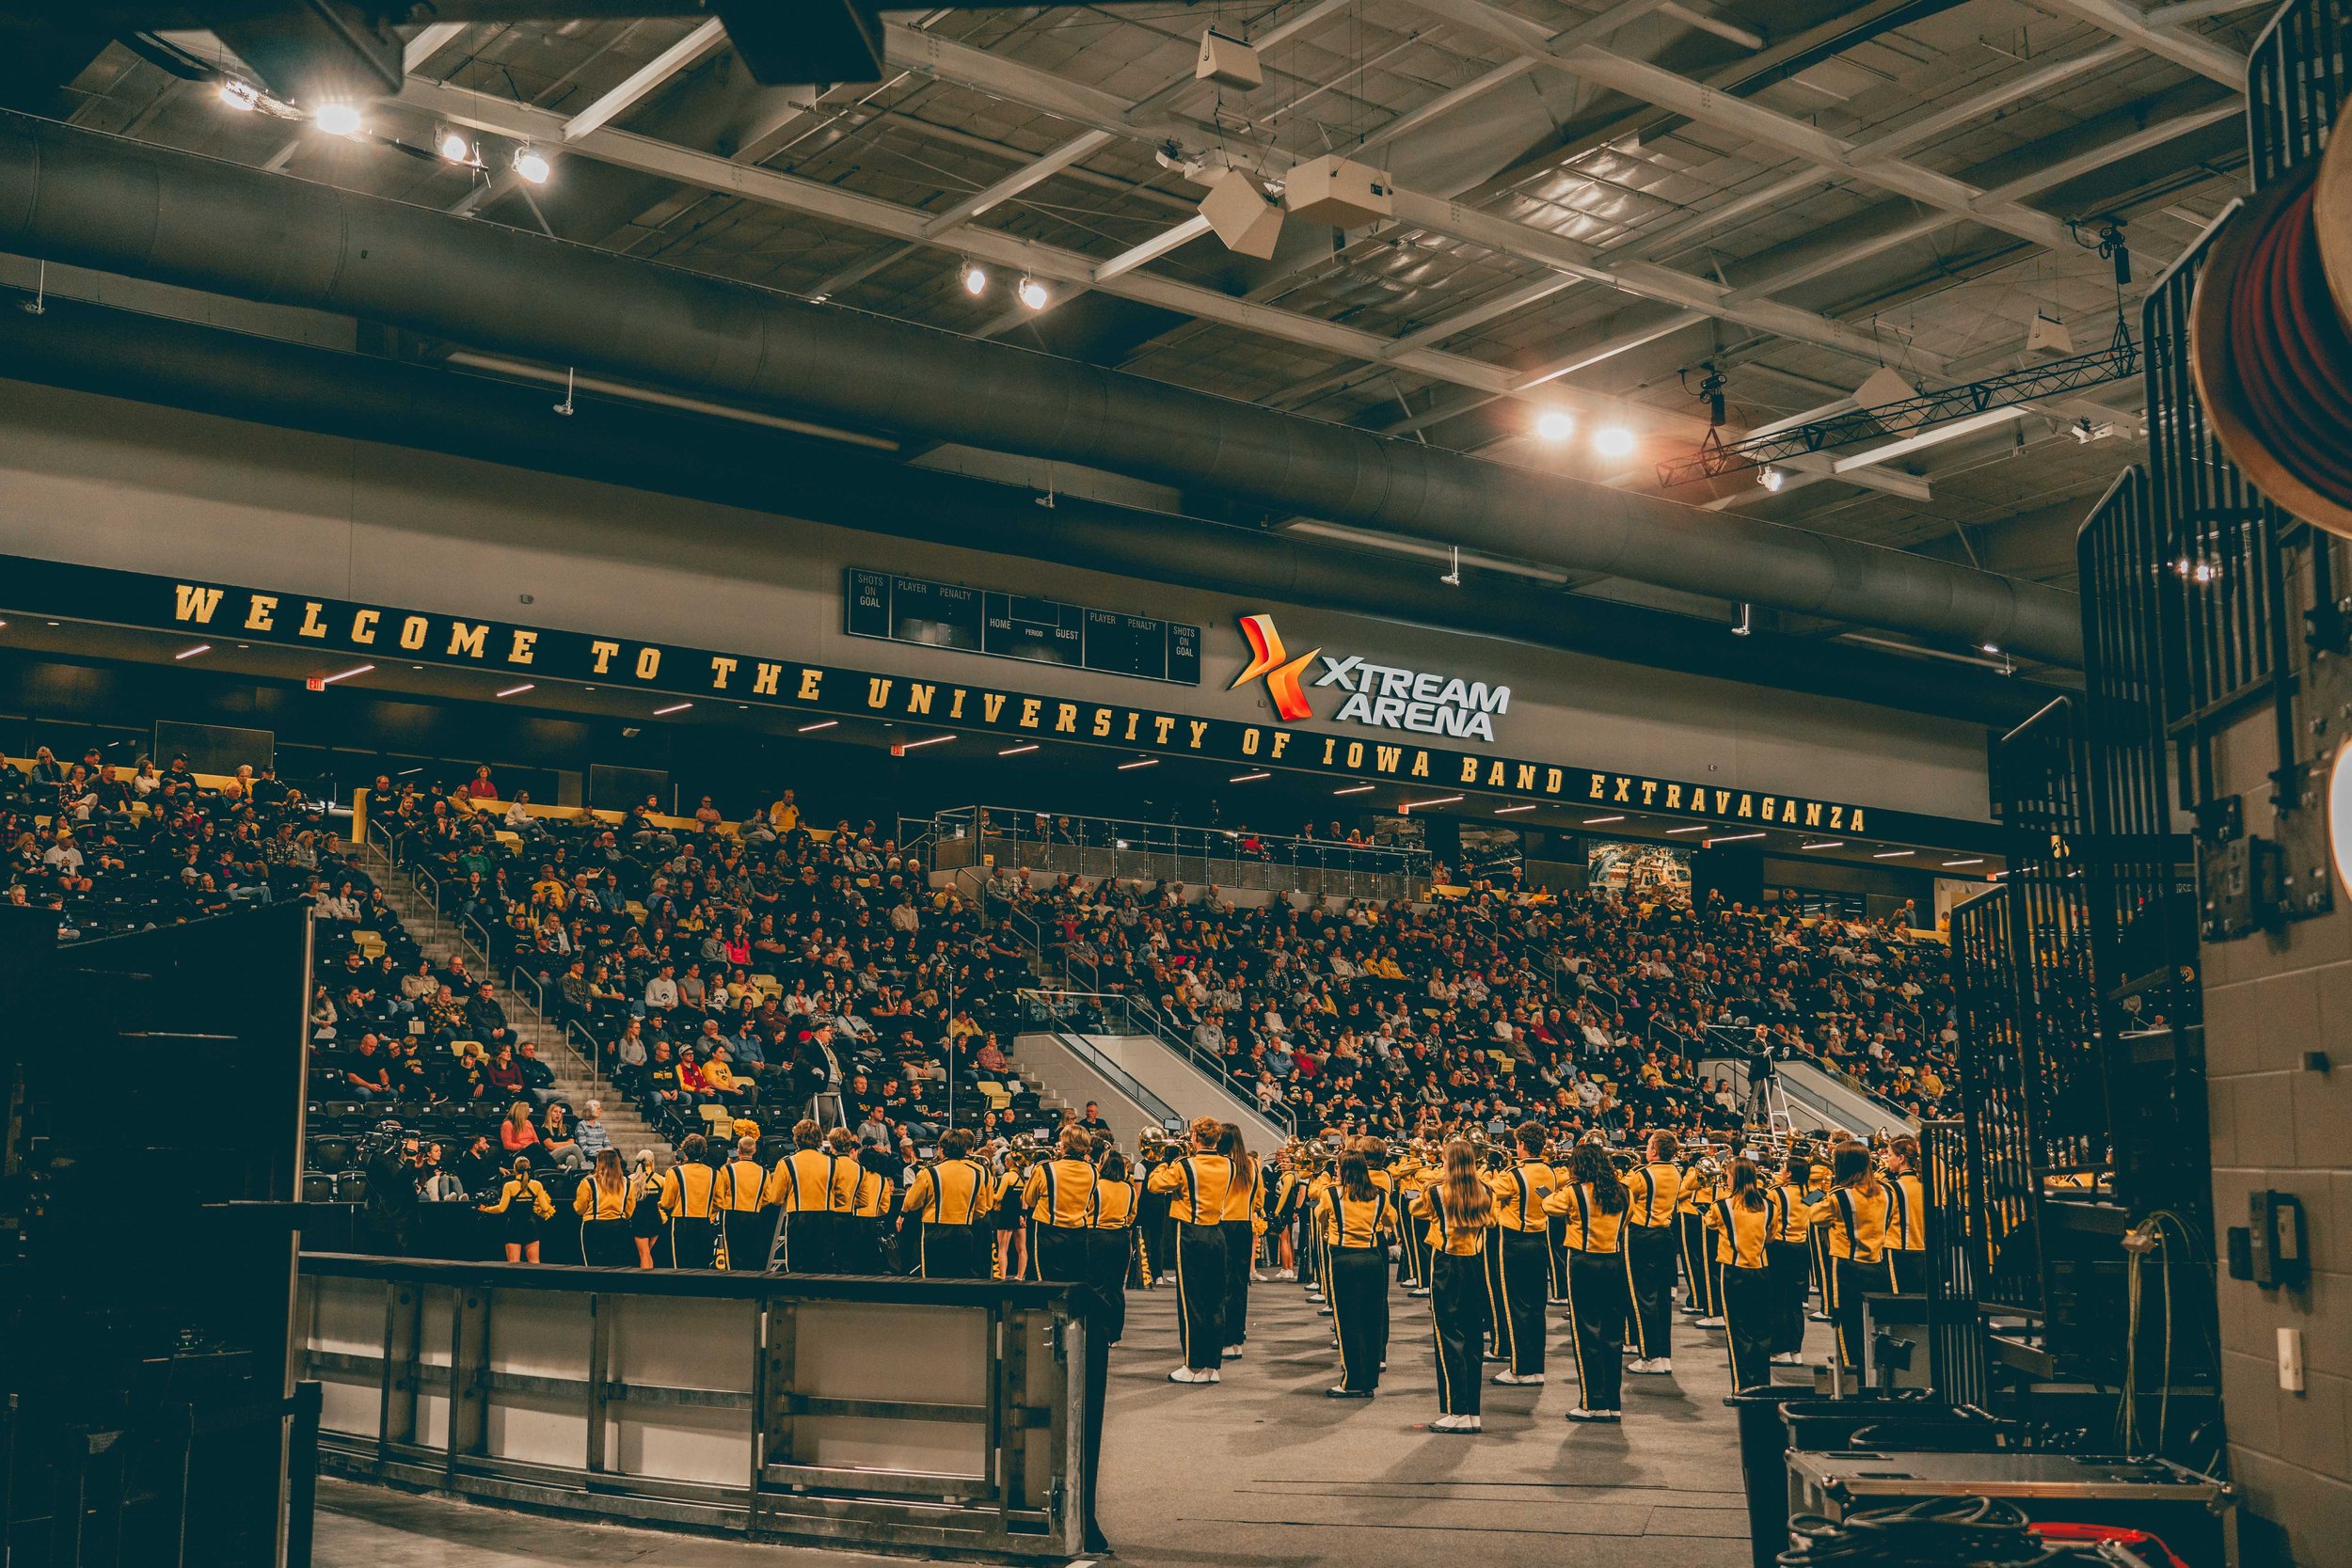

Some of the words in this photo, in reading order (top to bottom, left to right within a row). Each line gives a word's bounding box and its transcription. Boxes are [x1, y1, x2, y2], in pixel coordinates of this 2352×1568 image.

[857, 573, 883, 586] SHOTS
[898, 579, 927, 594] PLAYER
[865, 585, 876, 595] ON
[940, 586, 971, 602] PENALTY
[859, 595, 881, 608] GOAL
[989, 617, 1011, 630] HOME
[1089, 612, 1116, 626] PLAYER
[1127, 618, 1156, 632] PENALTY
[1025, 627, 1043, 638] PERIOD
[1055, 627, 1079, 641] GUEST
[1172, 626, 1195, 638] SHOTS
[1179, 636, 1189, 646] ON
[1175, 646, 1193, 657] GOAL
[1314, 655, 1511, 715] XTREAM
[175, 584, 538, 664] WELCOME
[591, 641, 661, 680] TO
[711, 657, 823, 701] THE
[867, 677, 1208, 749] UNIVERSITY
[1242, 728, 1291, 758] OF
[1323, 738, 1429, 777] IOWA
[1460, 756, 1563, 793] BAND
[1589, 774, 1864, 832] EXTRAVAGANZA
[1336, 692, 1495, 742] ARENA
[1138, 1238, 1153, 1287] IOWA
